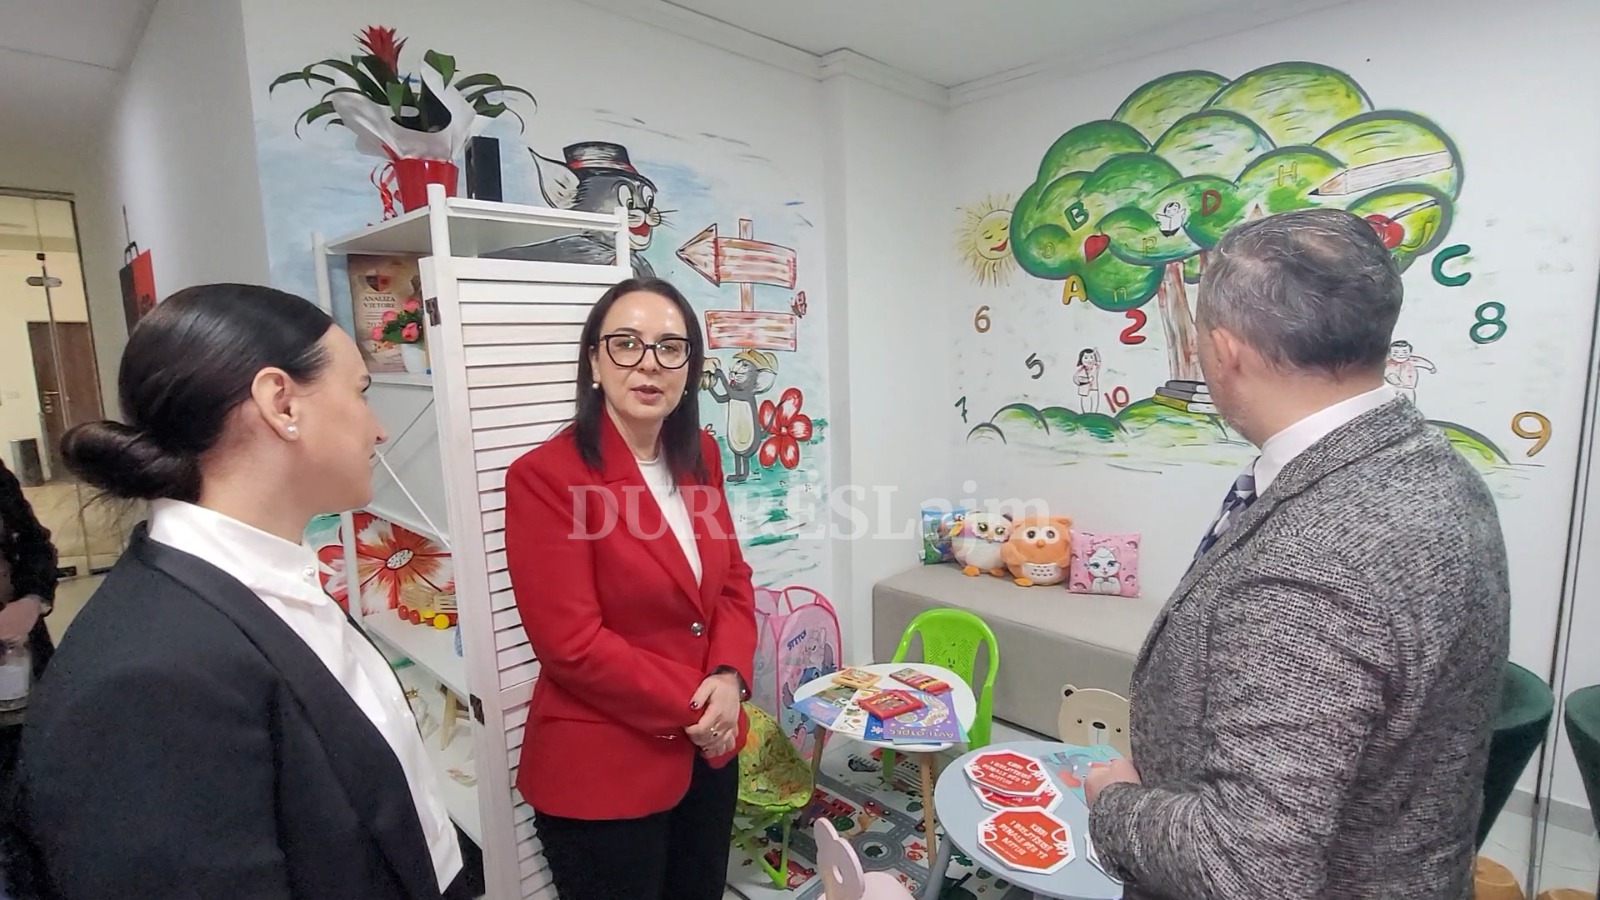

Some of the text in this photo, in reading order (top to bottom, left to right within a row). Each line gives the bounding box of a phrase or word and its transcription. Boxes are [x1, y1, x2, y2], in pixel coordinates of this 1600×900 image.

[1277, 161, 1297, 187] H
[1064, 200, 1090, 231] B
[1201, 189, 1222, 216] D
[1431, 243, 1472, 288] C
[1061, 274, 1088, 305] A
[974, 305, 991, 333] 6
[1119, 308, 1147, 345] 2
[1469, 301, 1507, 344] 8
[1025, 352, 1045, 380] 5
[1104, 386, 1130, 413] 10
[1511, 411, 1552, 457] 9
